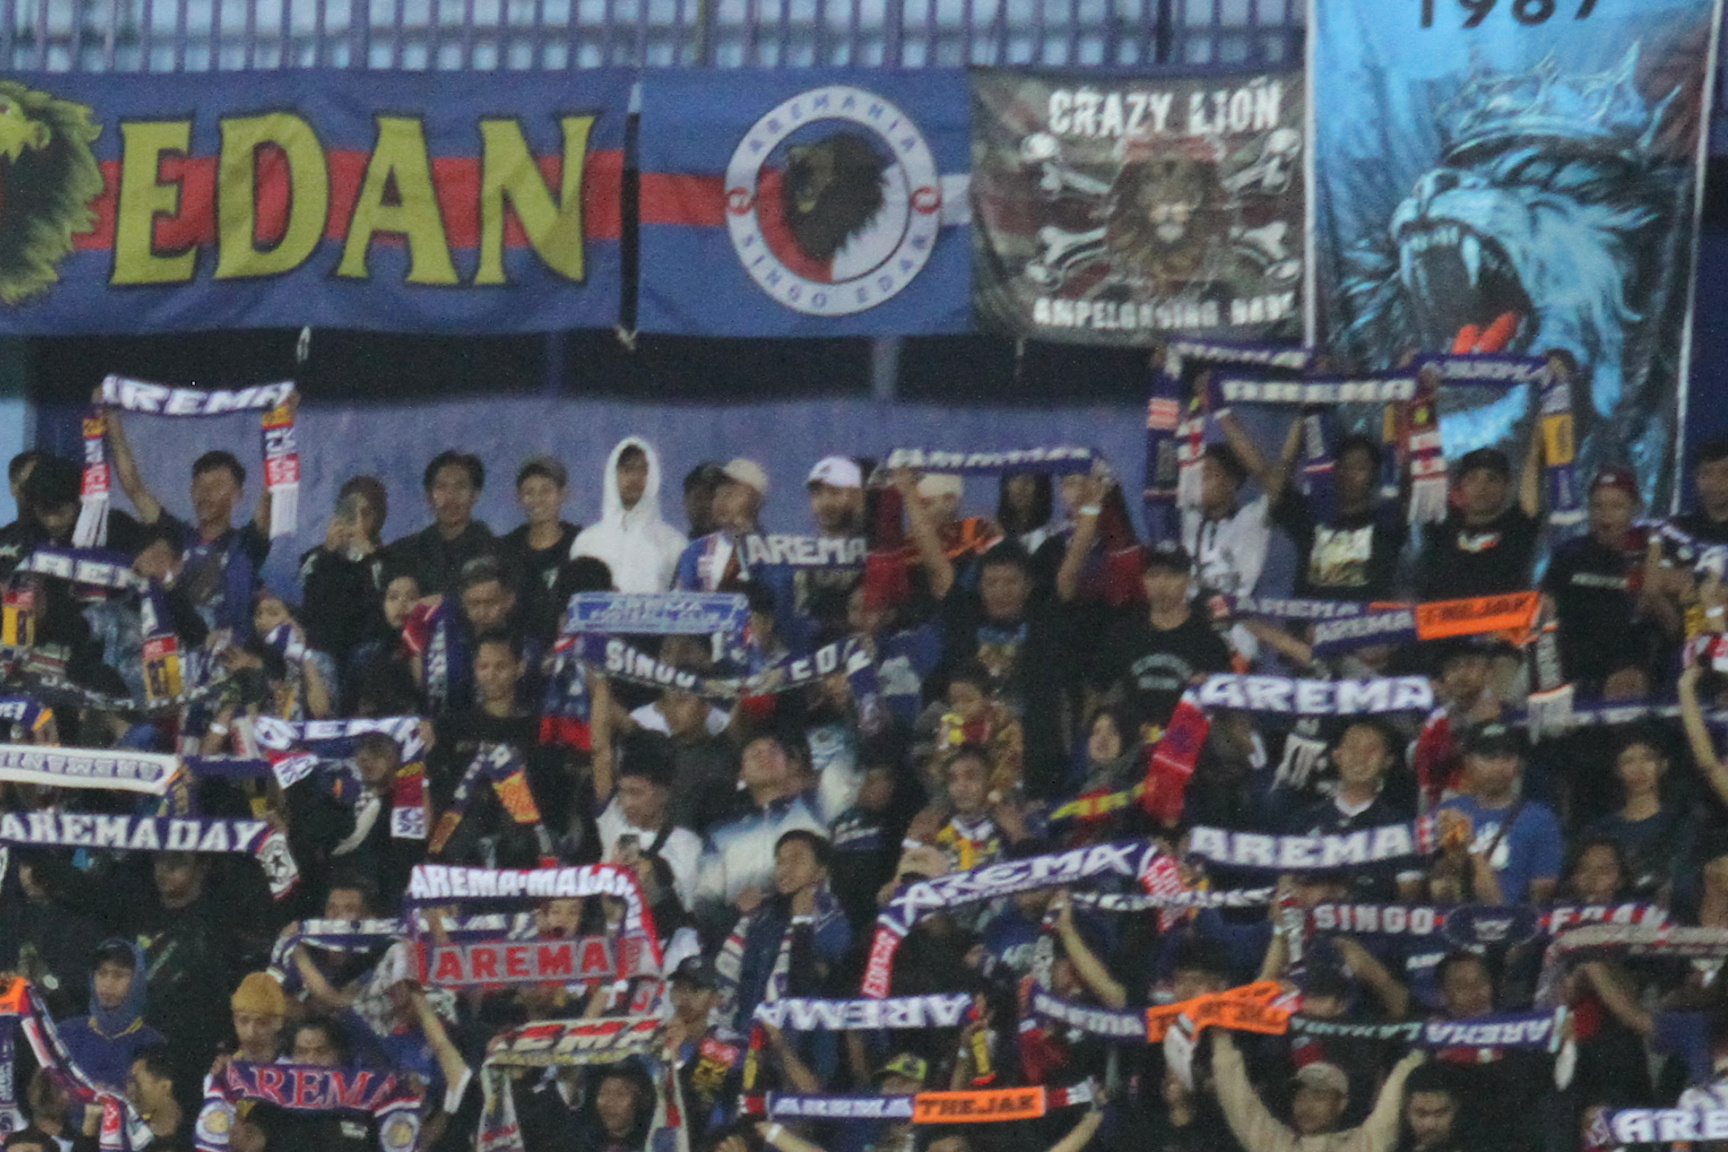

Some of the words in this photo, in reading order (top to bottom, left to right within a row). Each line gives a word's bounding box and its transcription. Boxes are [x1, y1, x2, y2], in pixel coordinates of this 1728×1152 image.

[1048, 87, 1174, 138] CRAZY
[1188, 80, 1282, 136] LION
[108, 110, 597, 290] EDAN
[747, 535, 867, 566] AREMA
[1198, 676, 1433, 713] AREMA
[0, 814, 161, 849] AREMA
[165, 819, 266, 852] DAY
[1190, 824, 1413, 869] AREMA
[890, 843, 1139, 912] AREMA
[1313, 904, 1438, 935] SINGO
[437, 938, 612, 984] AREMA
[754, 994, 969, 1030] AREMA
[775, 1098, 911, 1118] AREMA
